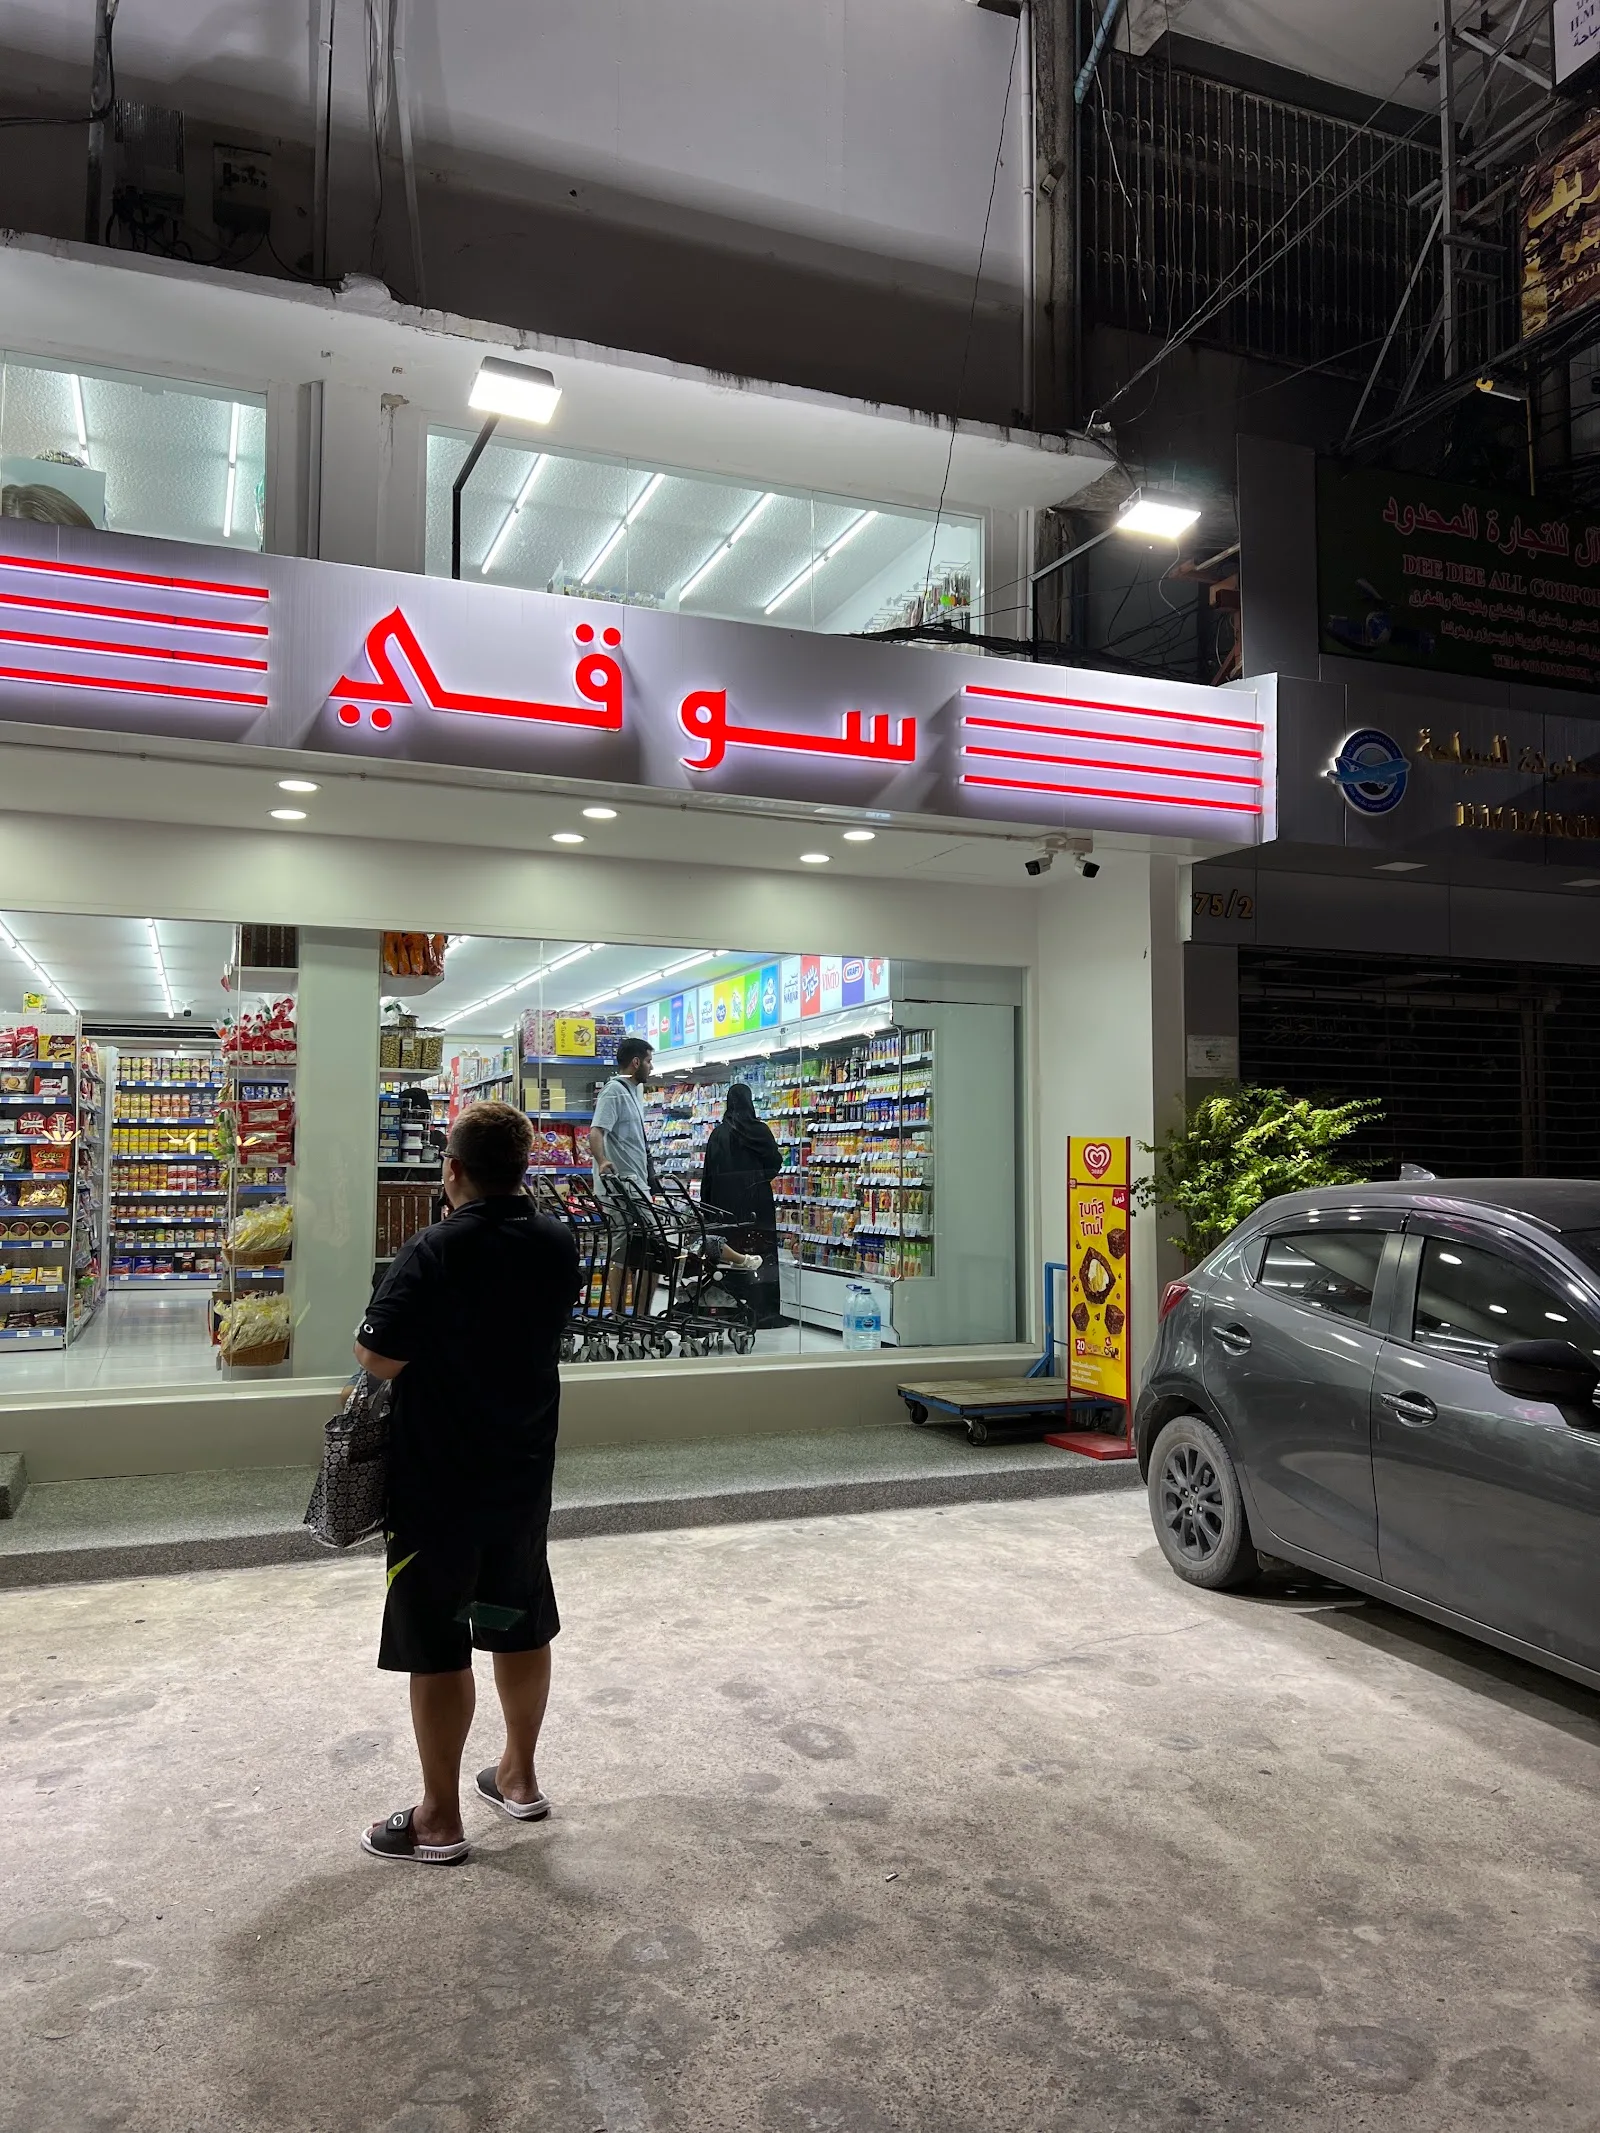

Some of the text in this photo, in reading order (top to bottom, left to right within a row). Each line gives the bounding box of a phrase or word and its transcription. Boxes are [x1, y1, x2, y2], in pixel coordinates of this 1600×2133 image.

[1485, 508, 1569, 559] للتجارة
[1402, 553, 1444, 580] DEE
[1445, 561, 1486, 588] DEE
[1487, 570, 1528, 595] ALL
[1194, 888, 1254, 919] 75/2
[1113, 1193, 1126, 1206] ใหม่
[1076, 1339, 1085, 1351] 20
